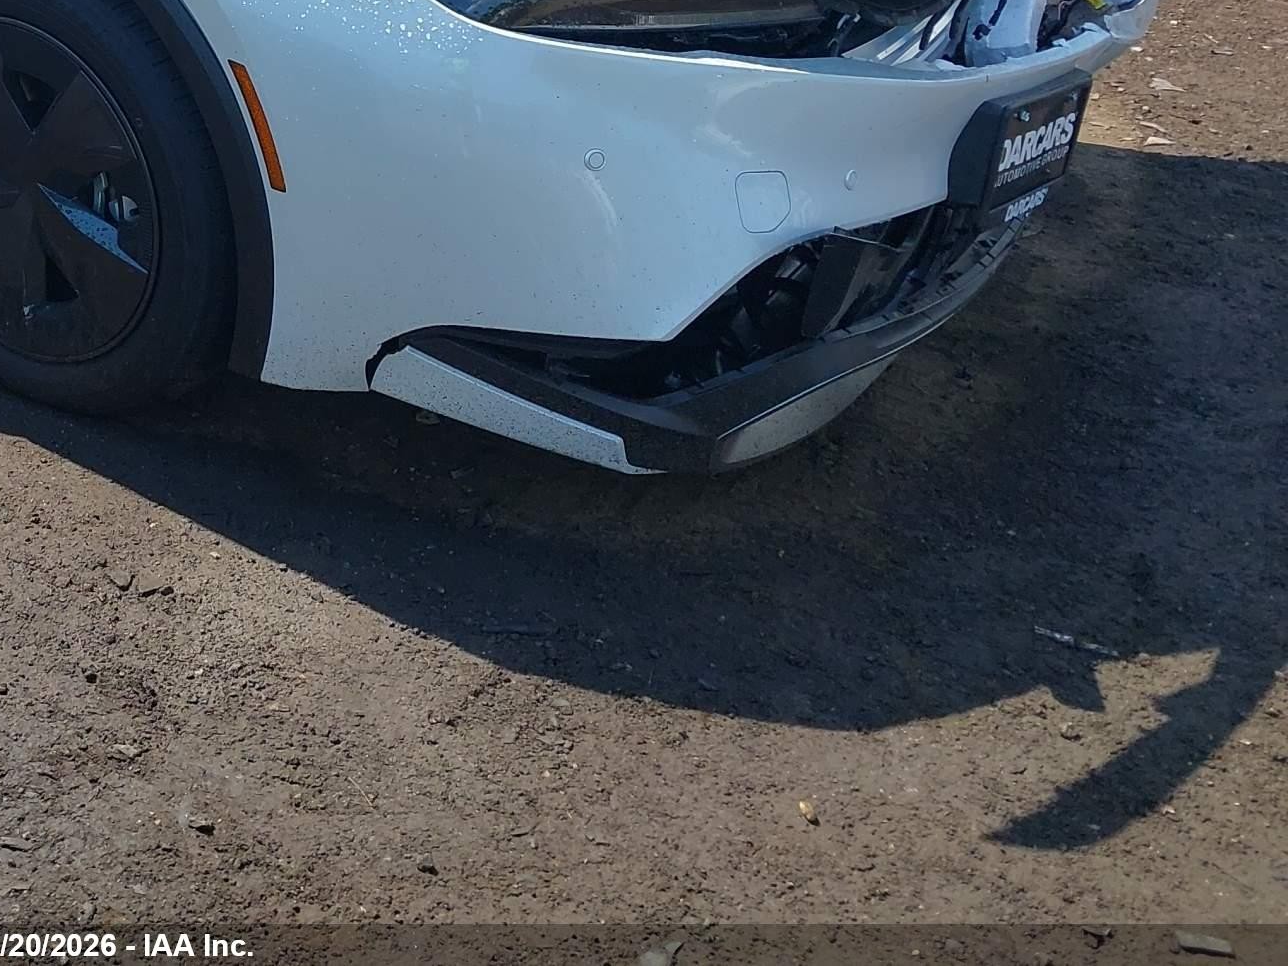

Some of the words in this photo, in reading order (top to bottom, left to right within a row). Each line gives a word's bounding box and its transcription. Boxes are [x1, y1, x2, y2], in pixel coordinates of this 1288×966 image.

[994, 156, 1041, 188] UTOMOTIVE
[1041, 145, 1070, 166] GROUP
[998, 112, 1076, 172] DARCARS
